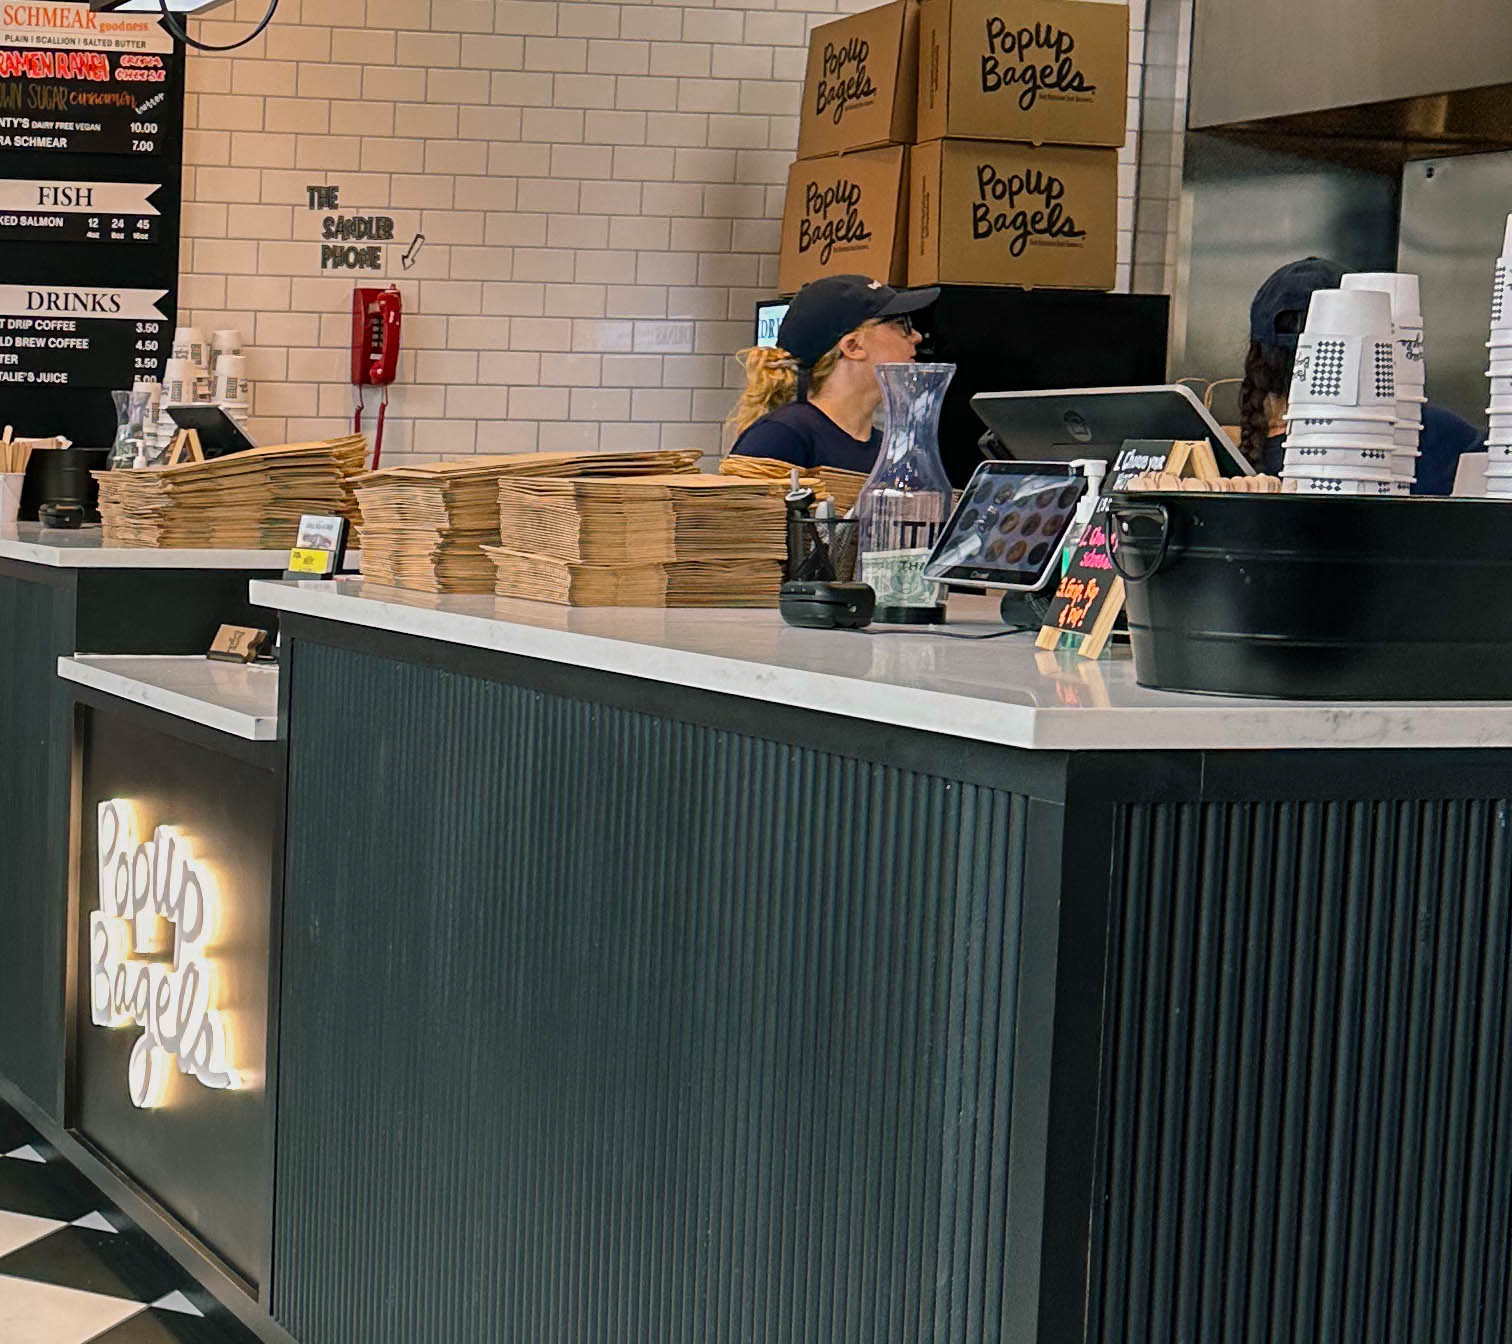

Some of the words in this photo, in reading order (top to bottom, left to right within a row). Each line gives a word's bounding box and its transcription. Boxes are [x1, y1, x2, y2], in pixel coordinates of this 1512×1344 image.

[3, 5, 97, 29] SCHMEAR
[99, 20, 149, 33] goodness
[5, 34, 29, 43] PLAIN
[36, 35, 76, 45] SCALLION
[83, 37, 112, 47] SALTED
[115, 39, 146, 49] BUTTER
[982, 55, 1096, 111] Bagels
[27, 83, 68, 111] SUGAR
[816, 65, 877, 126] Bagels
[31, 120, 54, 130] DAIRY
[55, 122, 74, 130] FREE
[75, 122, 101, 131] VEGAN
[130, 122, 158, 134] 10.00
[14, 136, 67, 148] SCHMEAR
[132, 140, 154, 152] 7.00
[37, 186, 93, 207] FISH
[306, 185, 339, 210] THE
[19, 216, 64, 227] SALMON
[88, 218, 99, 228] 12
[111, 219, 125, 229] 24
[136, 219, 150, 230] 45
[321, 215, 394, 241] SANDLER
[972, 201, 1086, 258] Bagels
[798, 208, 872, 265] Bagels
[320, 244, 382, 270] PHONE
[26, 290, 122, 313] DRINKS
[7, 318, 33, 330] DRIP
[34, 319, 76, 332] COFFEE
[135, 322, 159, 334] 3.50
[14, 337, 46, 348] BREW
[47, 337, 89, 349] COFFEE
[135, 340, 159, 351] 4.50
[134, 357, 158, 369] 3.50
[36, 372, 68, 384] JUICE
[134, 375, 158, 383] 5.00
[90, 911, 240, 1108] Bagels
